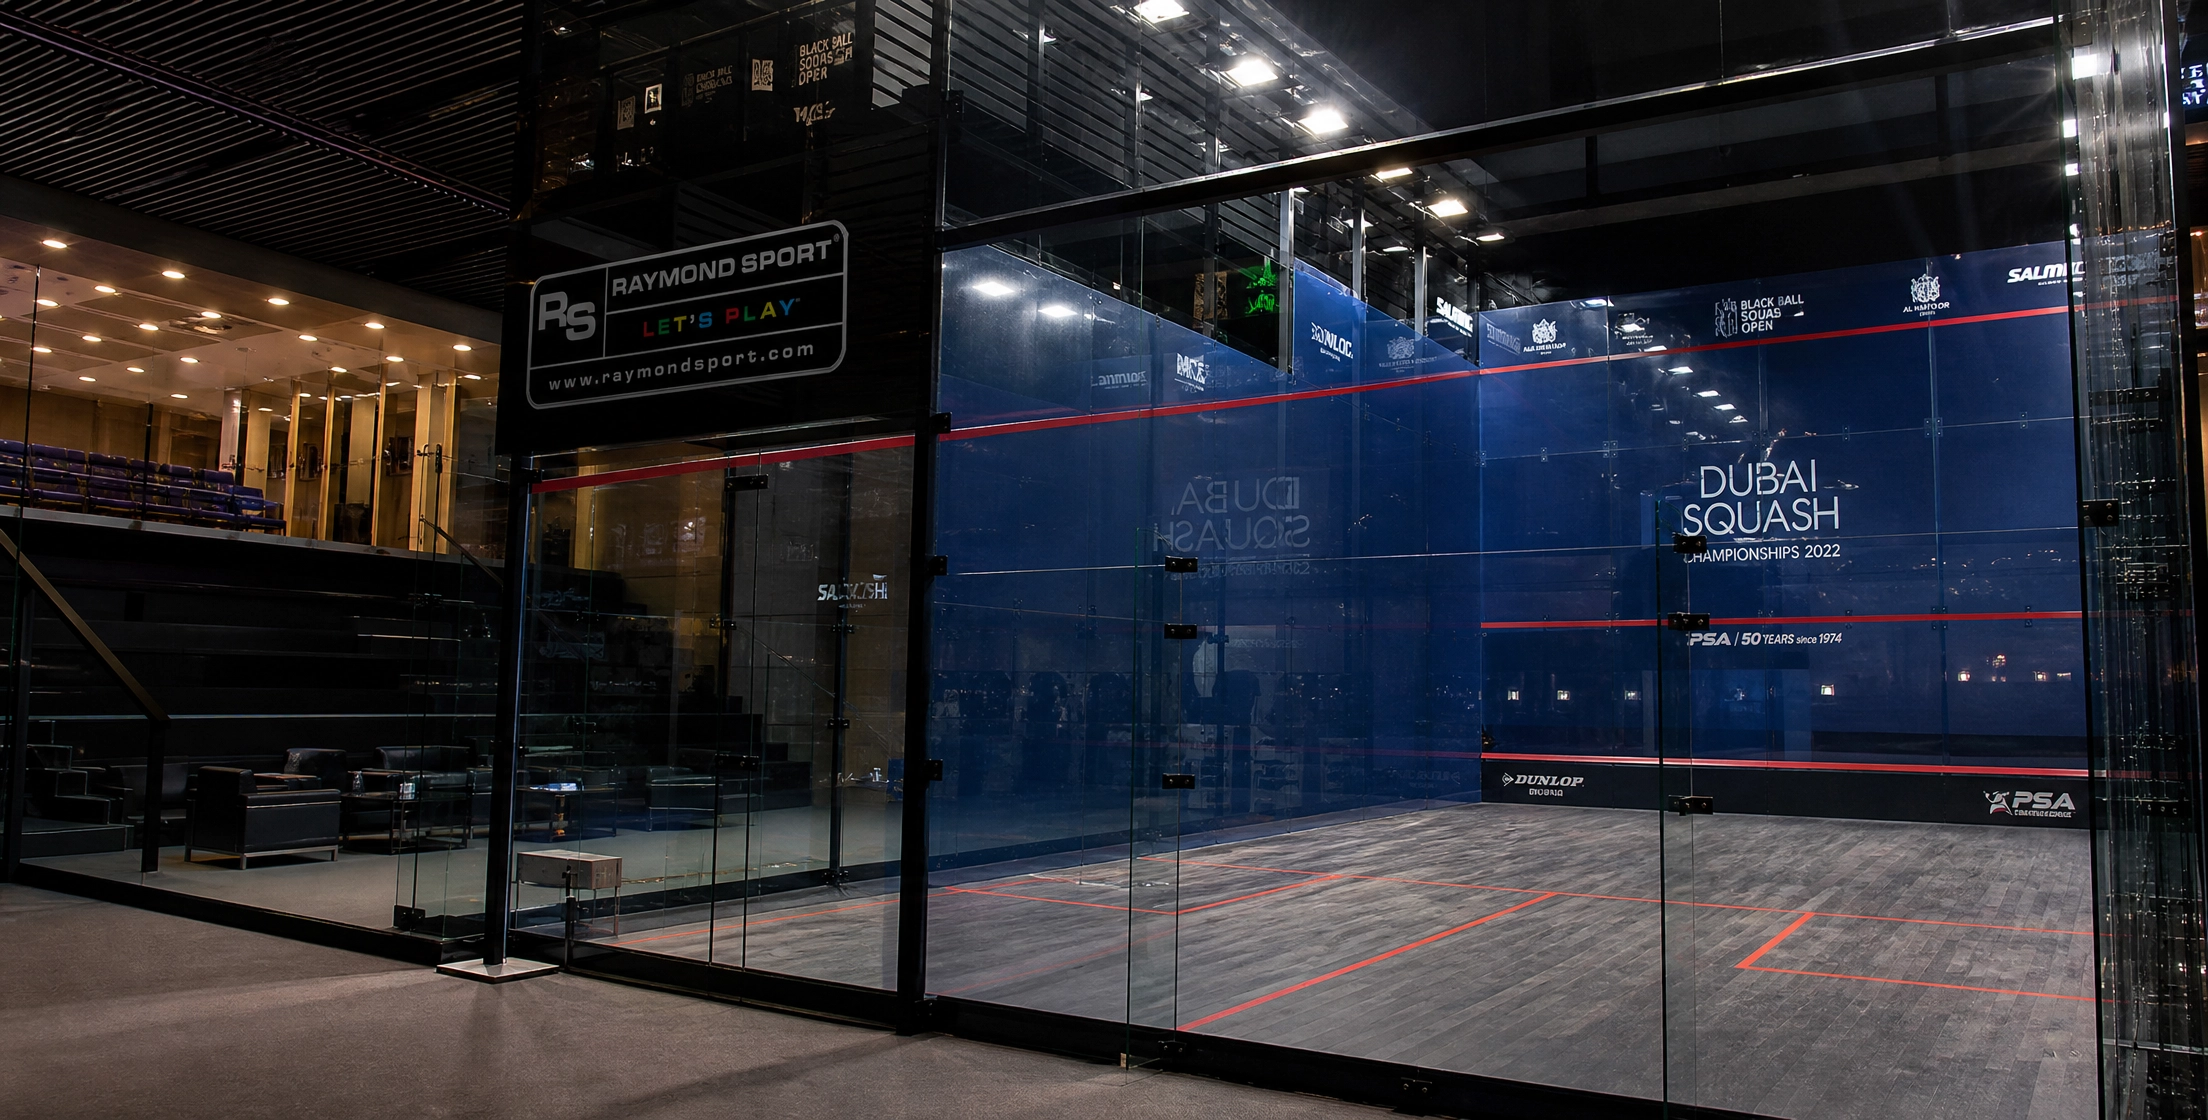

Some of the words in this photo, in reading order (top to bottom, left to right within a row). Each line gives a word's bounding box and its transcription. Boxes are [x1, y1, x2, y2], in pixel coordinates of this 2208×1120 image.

[612, 257, 736, 297] RAYMOND
[538, 291, 597, 341] RS
[1740, 296, 1775, 311] BLACK
[1777, 293, 1805, 307] BALL
[643, 311, 713, 338] LET'S
[725, 298, 796, 325] PLAY
[1741, 319, 1774, 334] OPEN
[549, 343, 814, 391] www.raymondsport.com
[1700, 459, 1817, 499] DUBAI
[1683, 496, 1840, 538] SQUASH
[1804, 543, 1841, 559] 2022
[1689, 632, 1731, 646] PSA
[1741, 632, 1761, 646] 50
[1763, 633, 1795, 646] YEARS
[1796, 635, 1818, 645] since
[1819, 632, 1843, 644] 1974
[1514, 774, 1585, 787] DUNLOP
[2011, 791, 2076, 810] PSA
